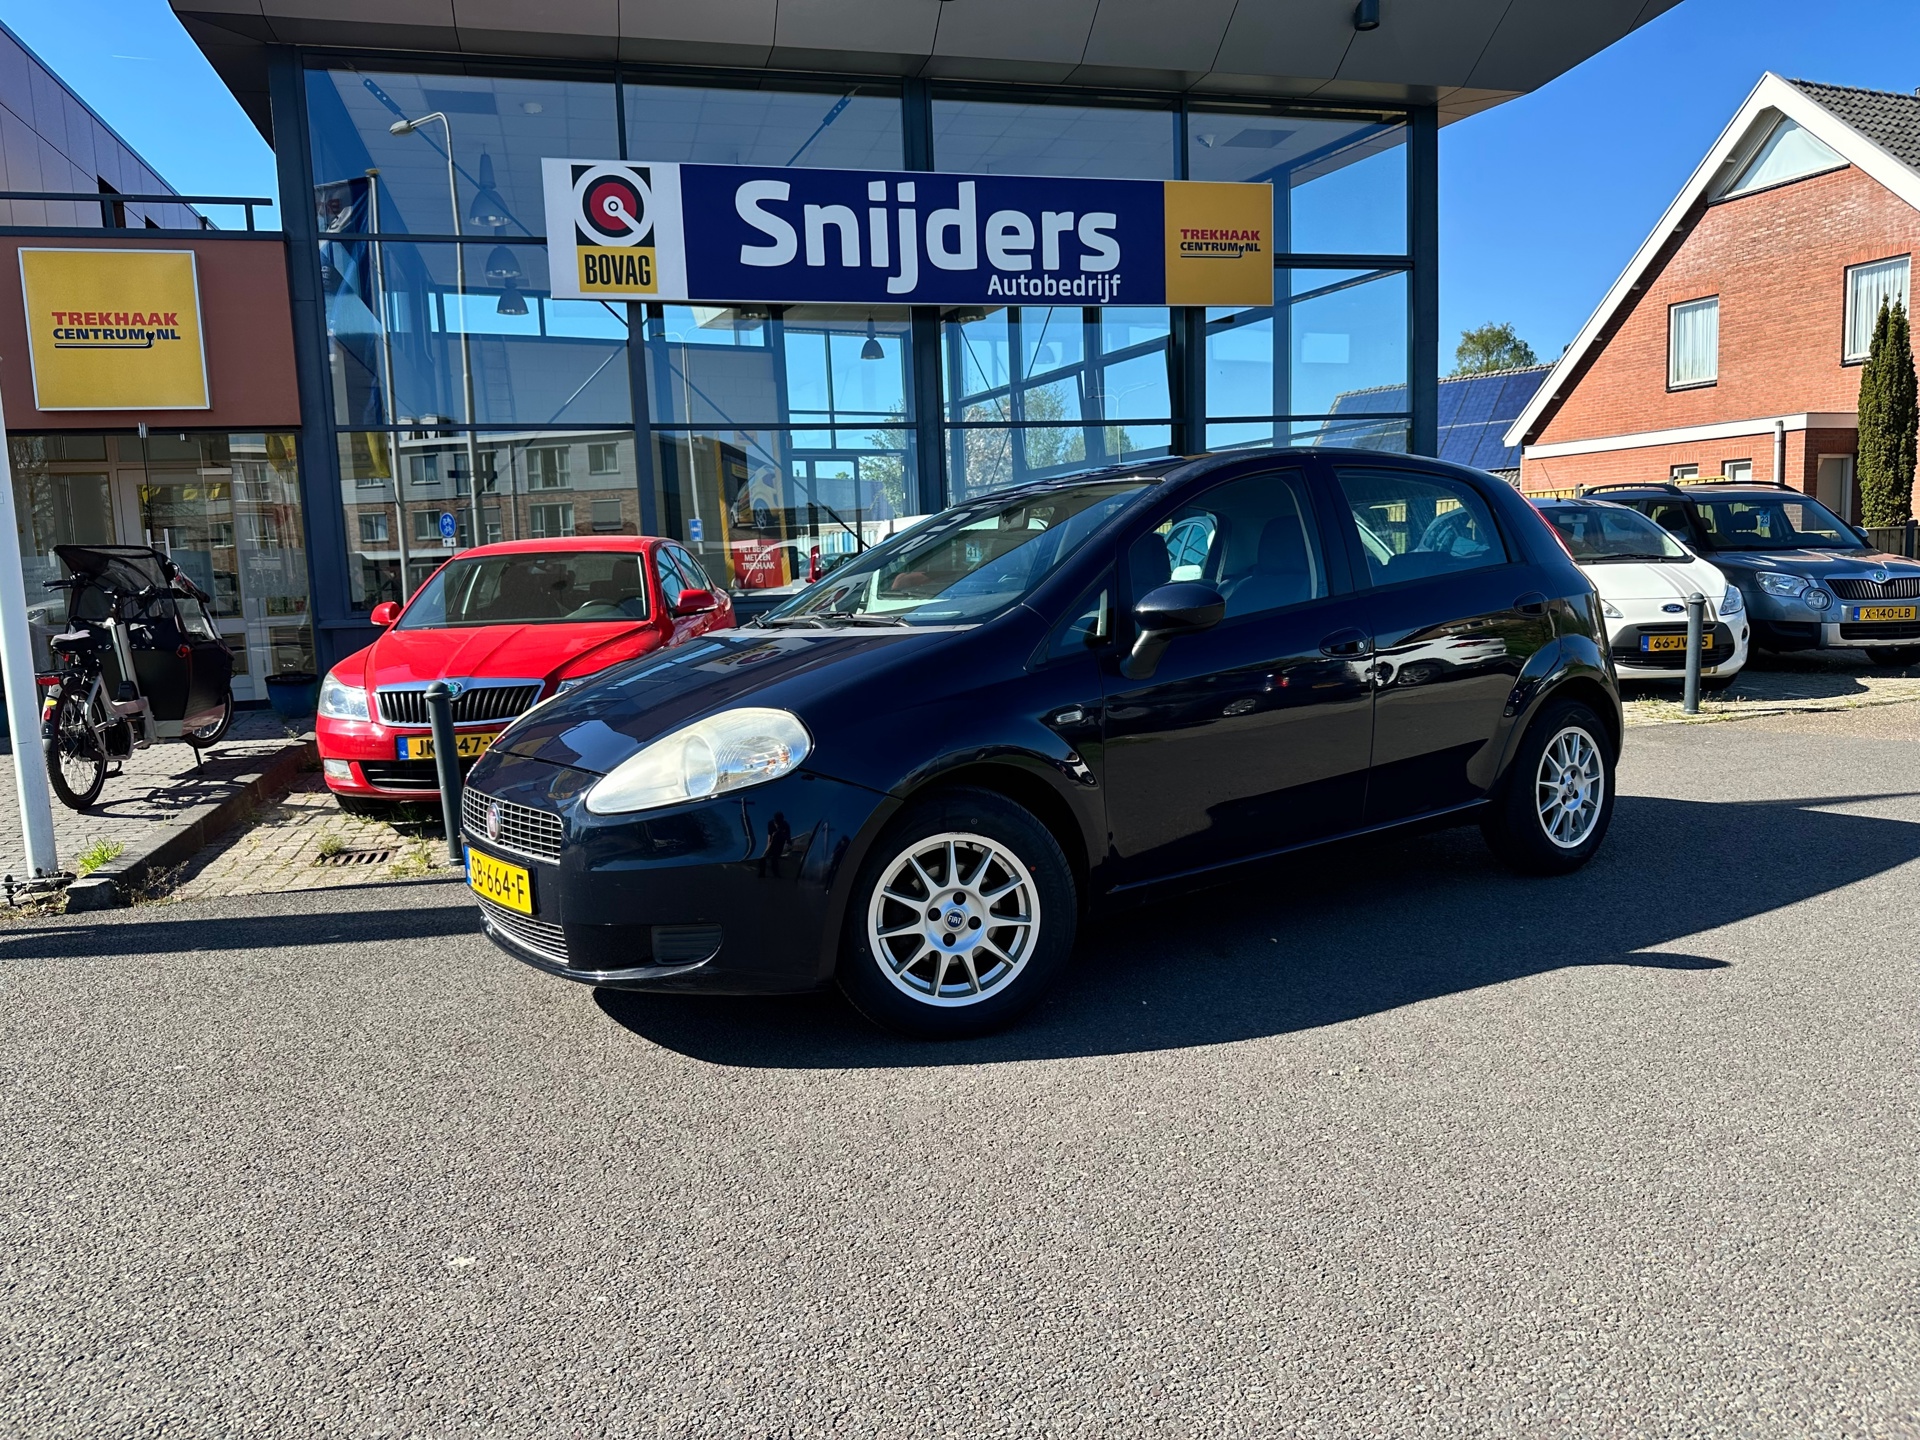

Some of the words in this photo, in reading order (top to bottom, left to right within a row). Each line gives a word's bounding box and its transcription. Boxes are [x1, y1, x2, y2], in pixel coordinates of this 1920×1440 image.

[734, 179, 1121, 294] Snijders
[1180, 228, 1260, 241] TREKHAAK
[584, 253, 652, 287] BOVAG
[987, 273, 1121, 303] Autobedrijf
[51, 311, 179, 326] TREKHAAK
[1864, 607, 1911, 619] X-140-LB
[471, 855, 525, 904] SB-664-F
[948, 916, 961, 924] FIAT
